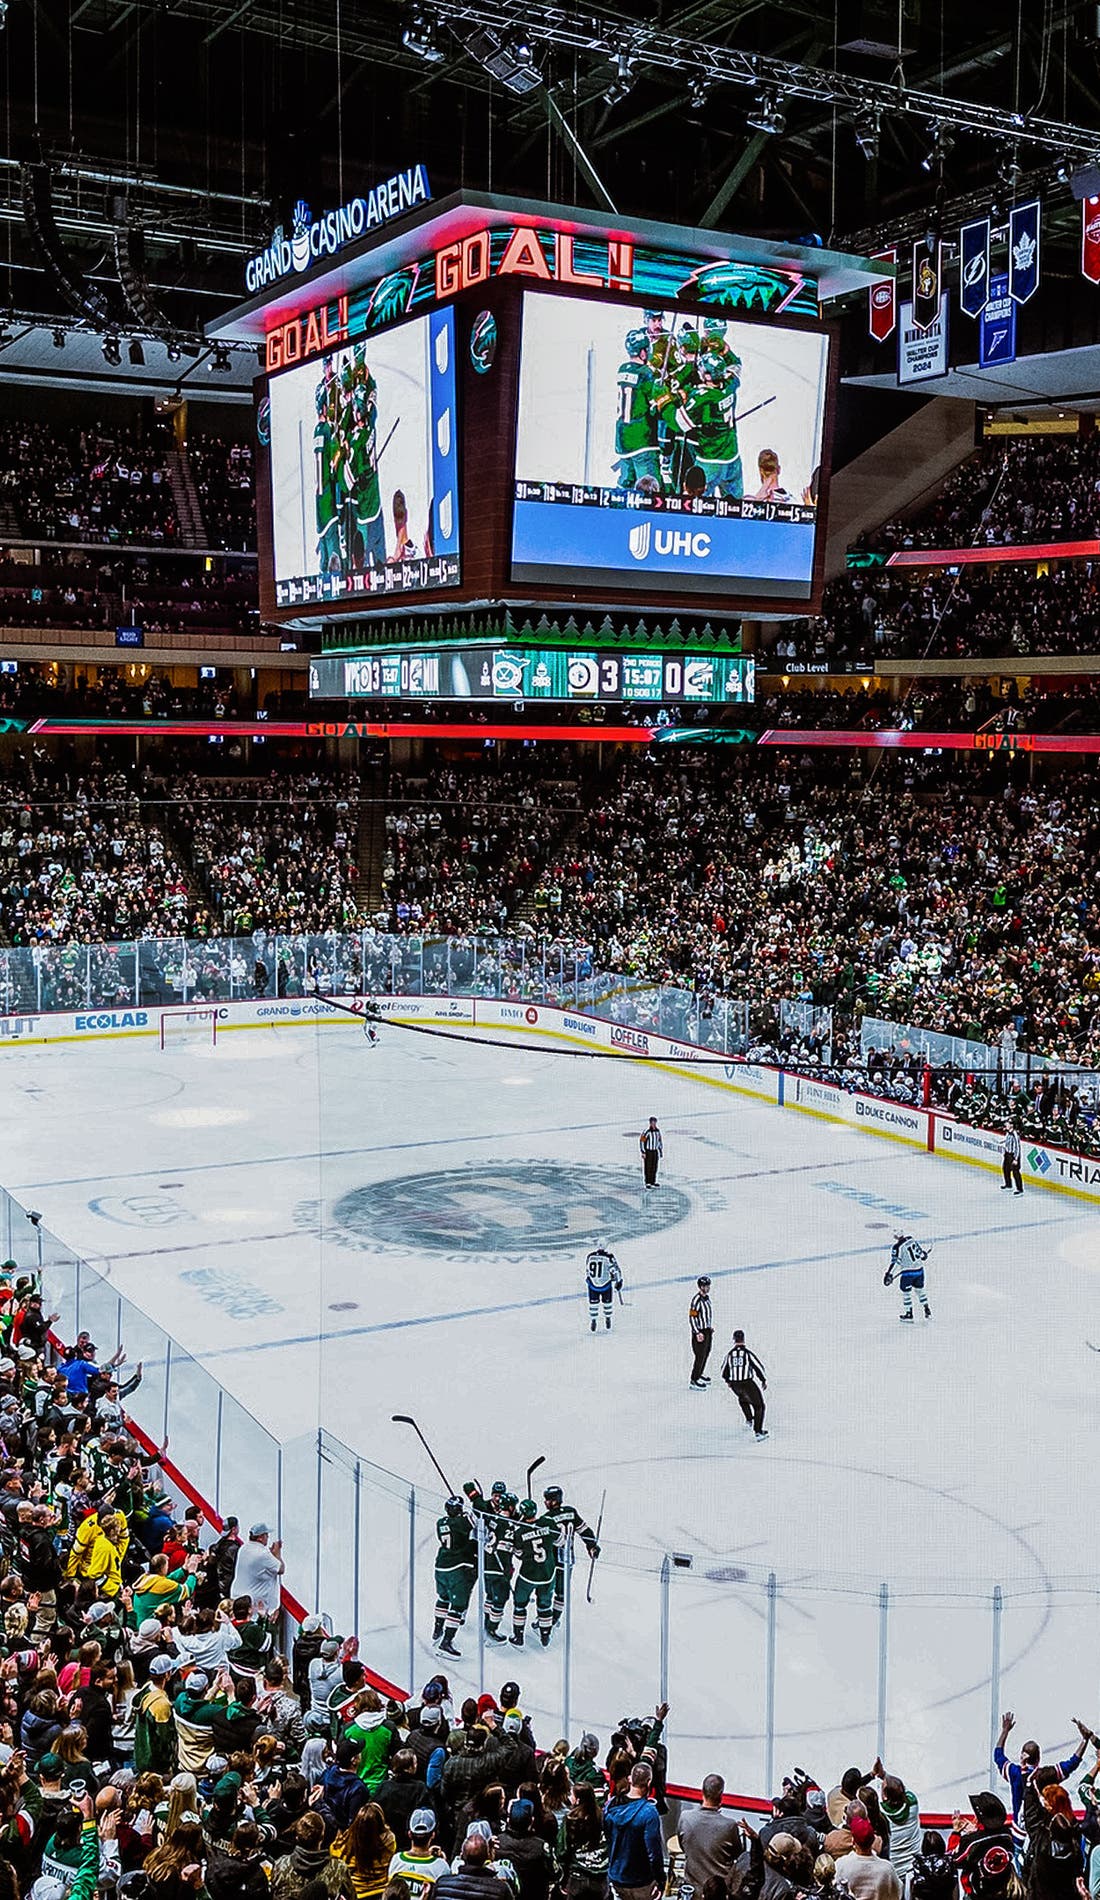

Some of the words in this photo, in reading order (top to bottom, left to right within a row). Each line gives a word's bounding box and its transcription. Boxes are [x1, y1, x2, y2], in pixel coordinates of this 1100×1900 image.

[245, 241, 291, 292] GRAND
[310, 199, 364, 256] CASINO
[366, 164, 430, 228] ARENA
[912, 361, 932, 373] 2024
[654, 530, 712, 558] UHC
[372, 661, 380, 690] 3
[401, 660, 409, 690] 0
[602, 660, 618, 692] 3
[623, 669, 661, 686] 15:07
[665, 662, 682, 694] 0
[785, 662, 806, 673] Club
[807, 662, 829, 673] Level
[256, 1006, 290, 1017] GRAND
[302, 1002, 337, 1014] CASINO
[391, 1001, 421, 1013] Energy
[500, 1008, 524, 1019] BMO
[75, 1012, 148, 1031] ECOLAB
[563, 1017, 579, 1030] BUD
[578, 1019, 597, 1036] LIGHT
[610, 1026, 649, 1050] LOFFLER
[864, 1104, 885, 1120] DUKE
[885, 1109, 919, 1130] CANNON
[588, 1261, 602, 1279] 91
[531, 1538, 547, 1563] 5
